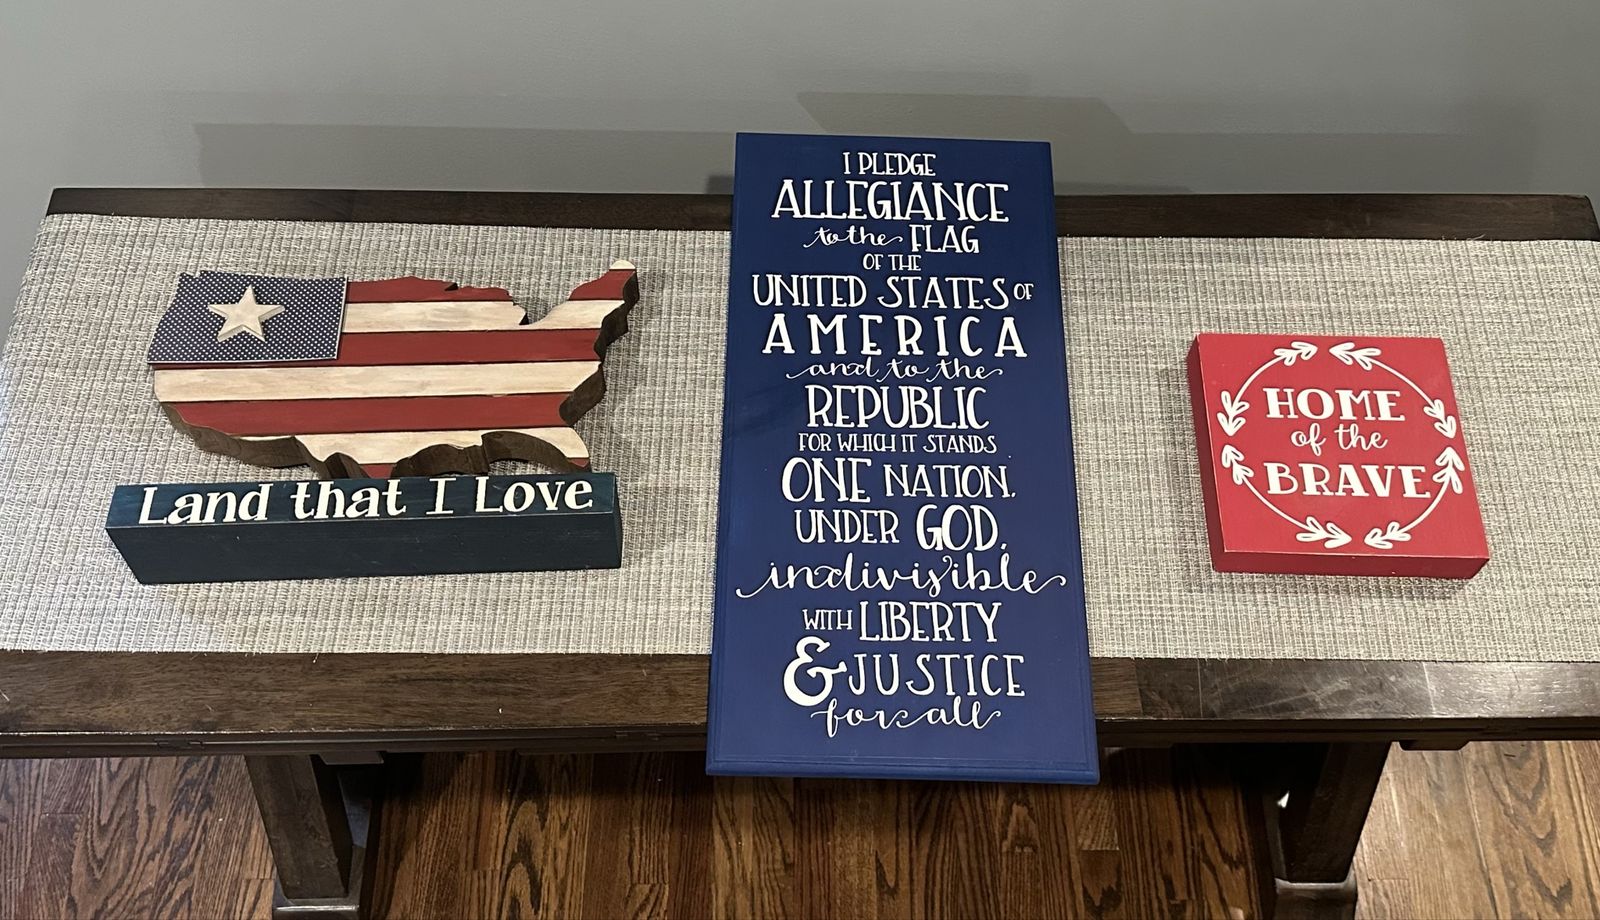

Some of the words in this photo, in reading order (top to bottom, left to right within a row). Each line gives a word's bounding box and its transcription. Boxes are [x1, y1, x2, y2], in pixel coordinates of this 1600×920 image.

[843, 152, 852, 175] I
[857, 153, 936, 177] PLEDGE
[771, 179, 1010, 222] ALLEGIANCE
[846, 226, 904, 248] the
[911, 225, 979, 254] FLAG
[863, 254, 883, 270] OF
[890, 254, 921, 271] THE
[752, 274, 867, 308] UNITED
[877, 276, 1009, 310] STATES
[1013, 283, 1034, 301] OF
[762, 313, 1027, 358] AMERICA
[786, 357, 878, 379] and
[926, 358, 1003, 382] the
[805, 384, 990, 430] REPUBLIC
[1263, 387, 1406, 422] HOME
[798, 433, 831, 452] FOR
[837, 434, 896, 452] WHICH
[901, 435, 917, 452] IT
[923, 435, 997, 454] STANDS
[1290, 422, 1326, 457] of
[1333, 423, 1389, 451] the
[781, 457, 872, 503] ONE
[1263, 462, 1432, 499] BRAVE
[137, 483, 272, 526] Land
[290, 479, 407, 519] that
[424, 478, 458, 516] I
[473, 475, 595, 513] Love
[794, 509, 900, 543] UNDER
[736, 552, 1067, 598] indivisible
[803, 609, 853, 630] WITH
[859, 601, 1002, 642] LIBERTY
[848, 653, 1026, 697] JUSTICE
[811, 698, 909, 738] for
[896, 696, 1002, 730] all
